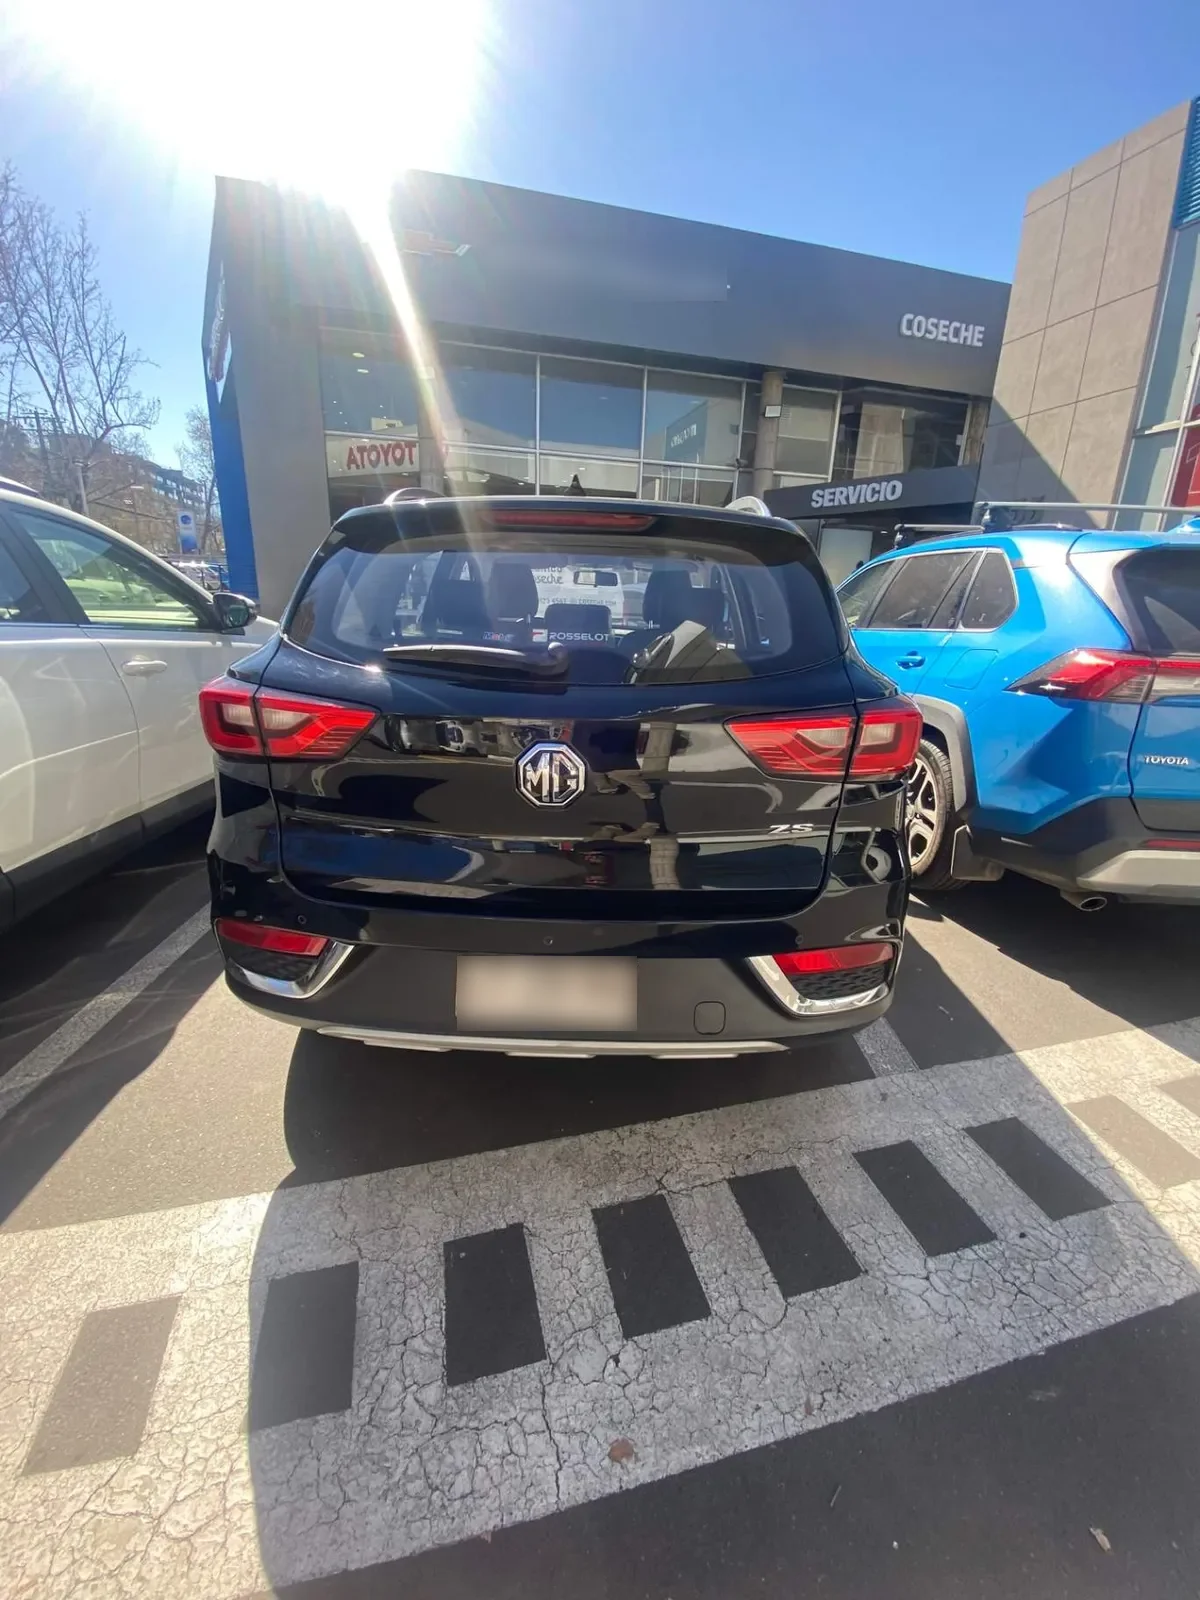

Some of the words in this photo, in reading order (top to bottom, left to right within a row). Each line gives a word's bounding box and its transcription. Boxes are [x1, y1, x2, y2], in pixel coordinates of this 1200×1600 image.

[901, 313, 985, 347] COSECHE
[811, 480, 903, 508] SERVICIO
[549, 631, 609, 641] ROSSELOT
[1144, 755, 1189, 765] TOYOTA
[525, 752, 577, 802] MG
[770, 823, 814, 834] ZS
